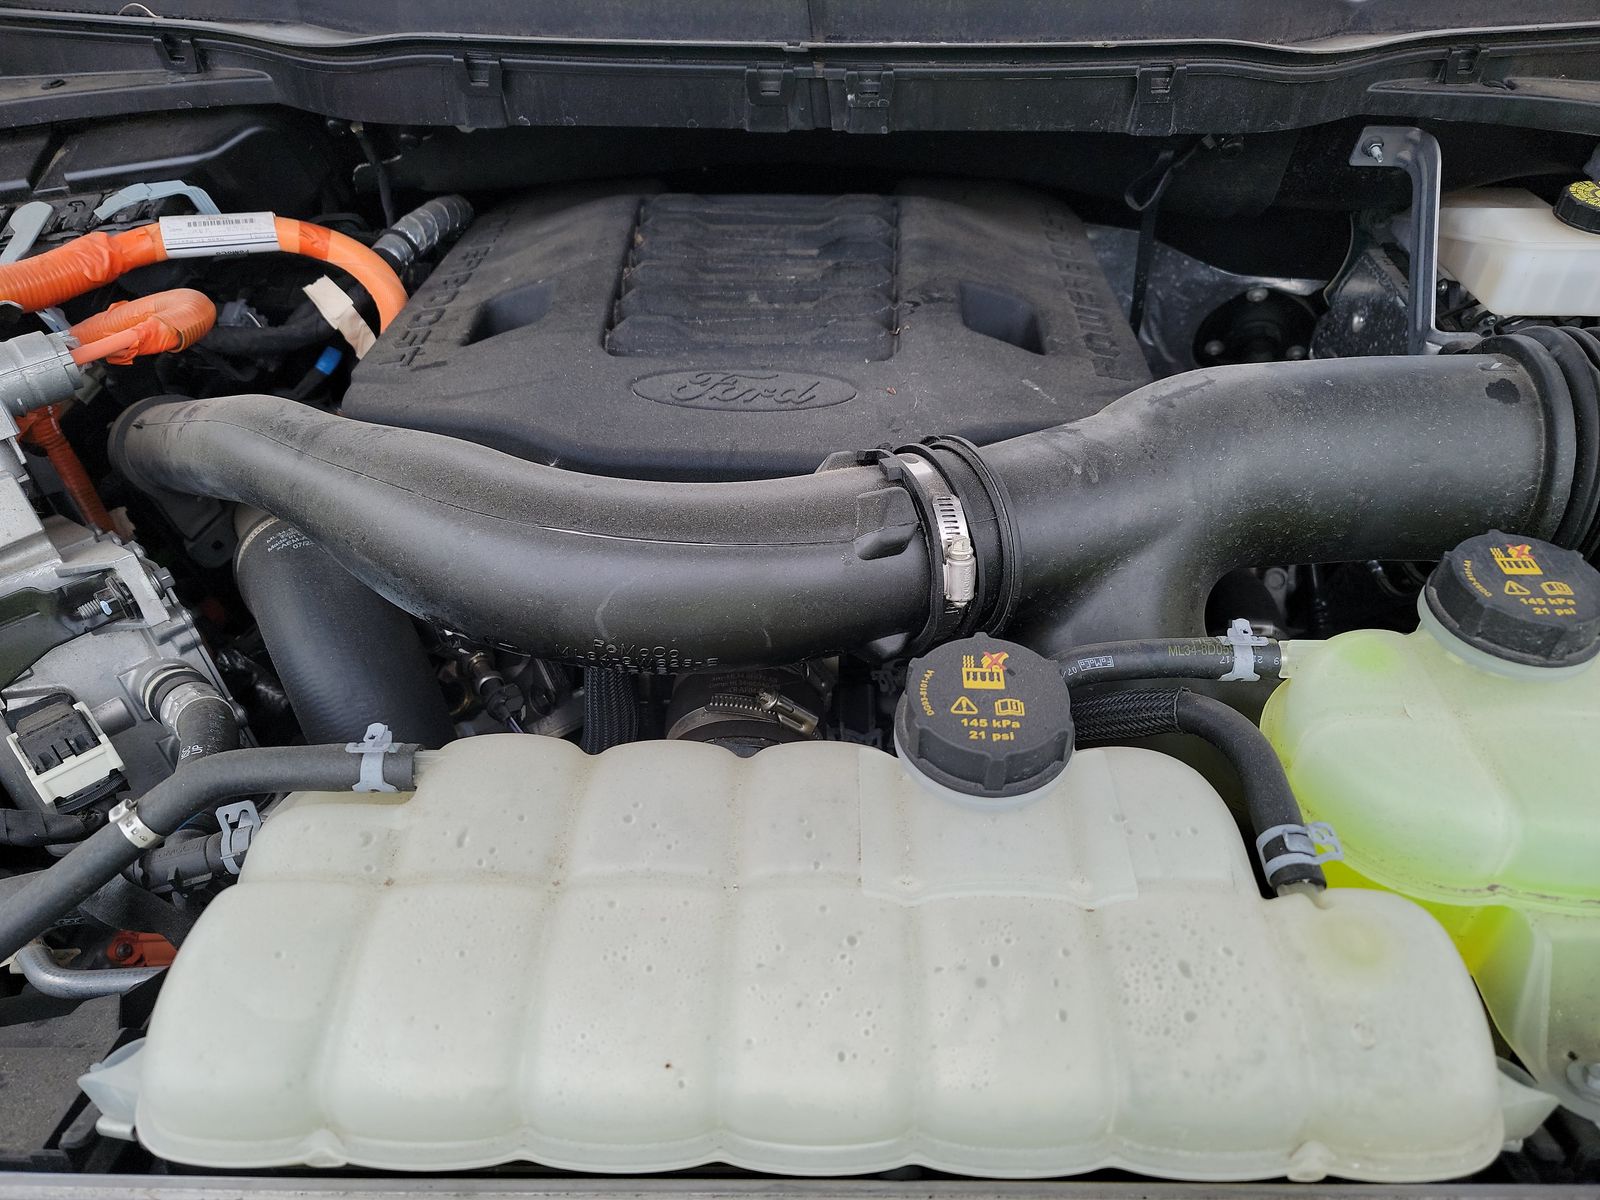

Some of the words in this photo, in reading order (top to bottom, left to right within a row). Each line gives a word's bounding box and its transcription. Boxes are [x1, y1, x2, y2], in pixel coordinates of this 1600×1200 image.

[670, 371, 821, 404] Ford
[1519, 597, 1546, 606] 145
[1547, 597, 1576, 606] kPa
[1532, 607, 1550, 615] 21
[1554, 607, 1577, 616] psi
[960, 718, 988, 728] 145
[991, 718, 1021, 729] kPa
[968, 730, 986, 740] 21
[991, 730, 1015, 742] psi
